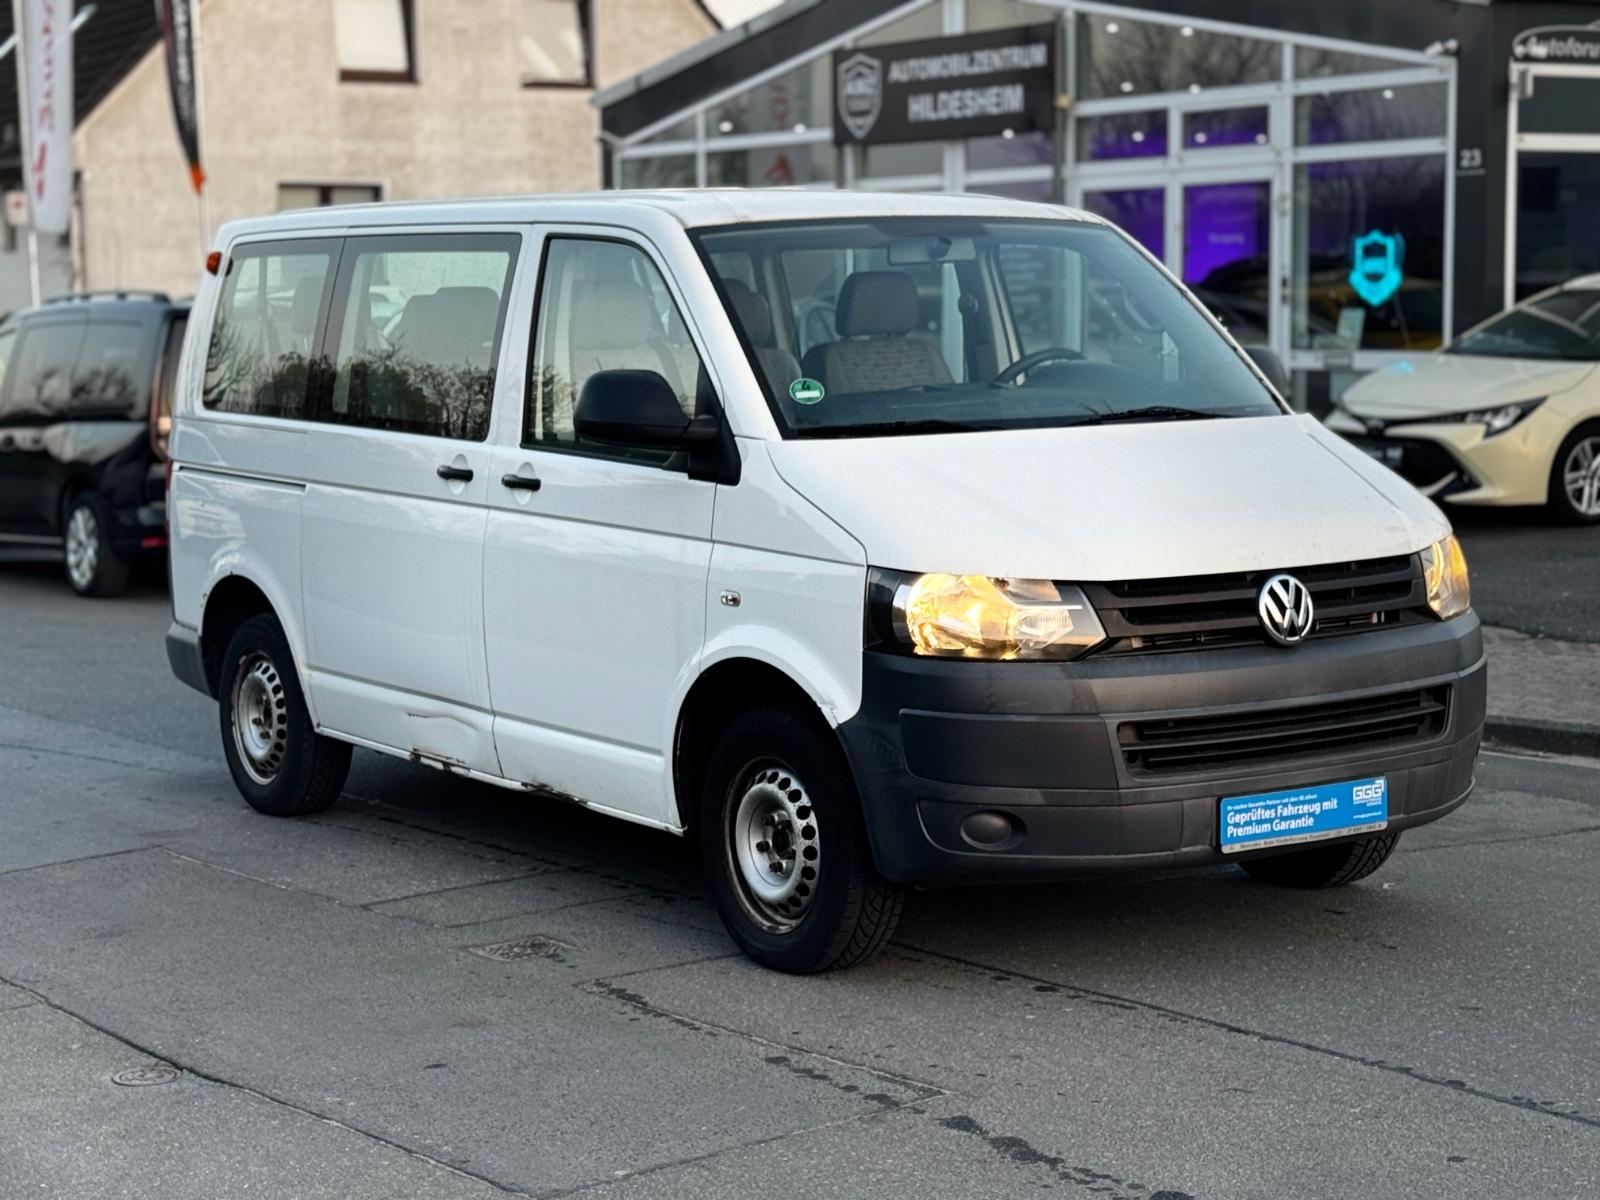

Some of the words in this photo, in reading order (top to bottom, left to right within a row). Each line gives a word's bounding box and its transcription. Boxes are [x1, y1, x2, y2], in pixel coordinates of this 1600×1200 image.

[888, 43, 1048, 83] AUTOMOBILZENTRUM
[907, 84, 1025, 122] HILDESHEIM
[1460, 148, 1482, 167] 23
[1353, 781, 1383, 800] GGG
[1227, 807, 1276, 825] Geprüftes
[1277, 801, 1321, 816] Fahrzeug
[1322, 798, 1338, 811] mit
[1227, 821, 1271, 838] Premium
[1272, 815, 1314, 832] Garantie
